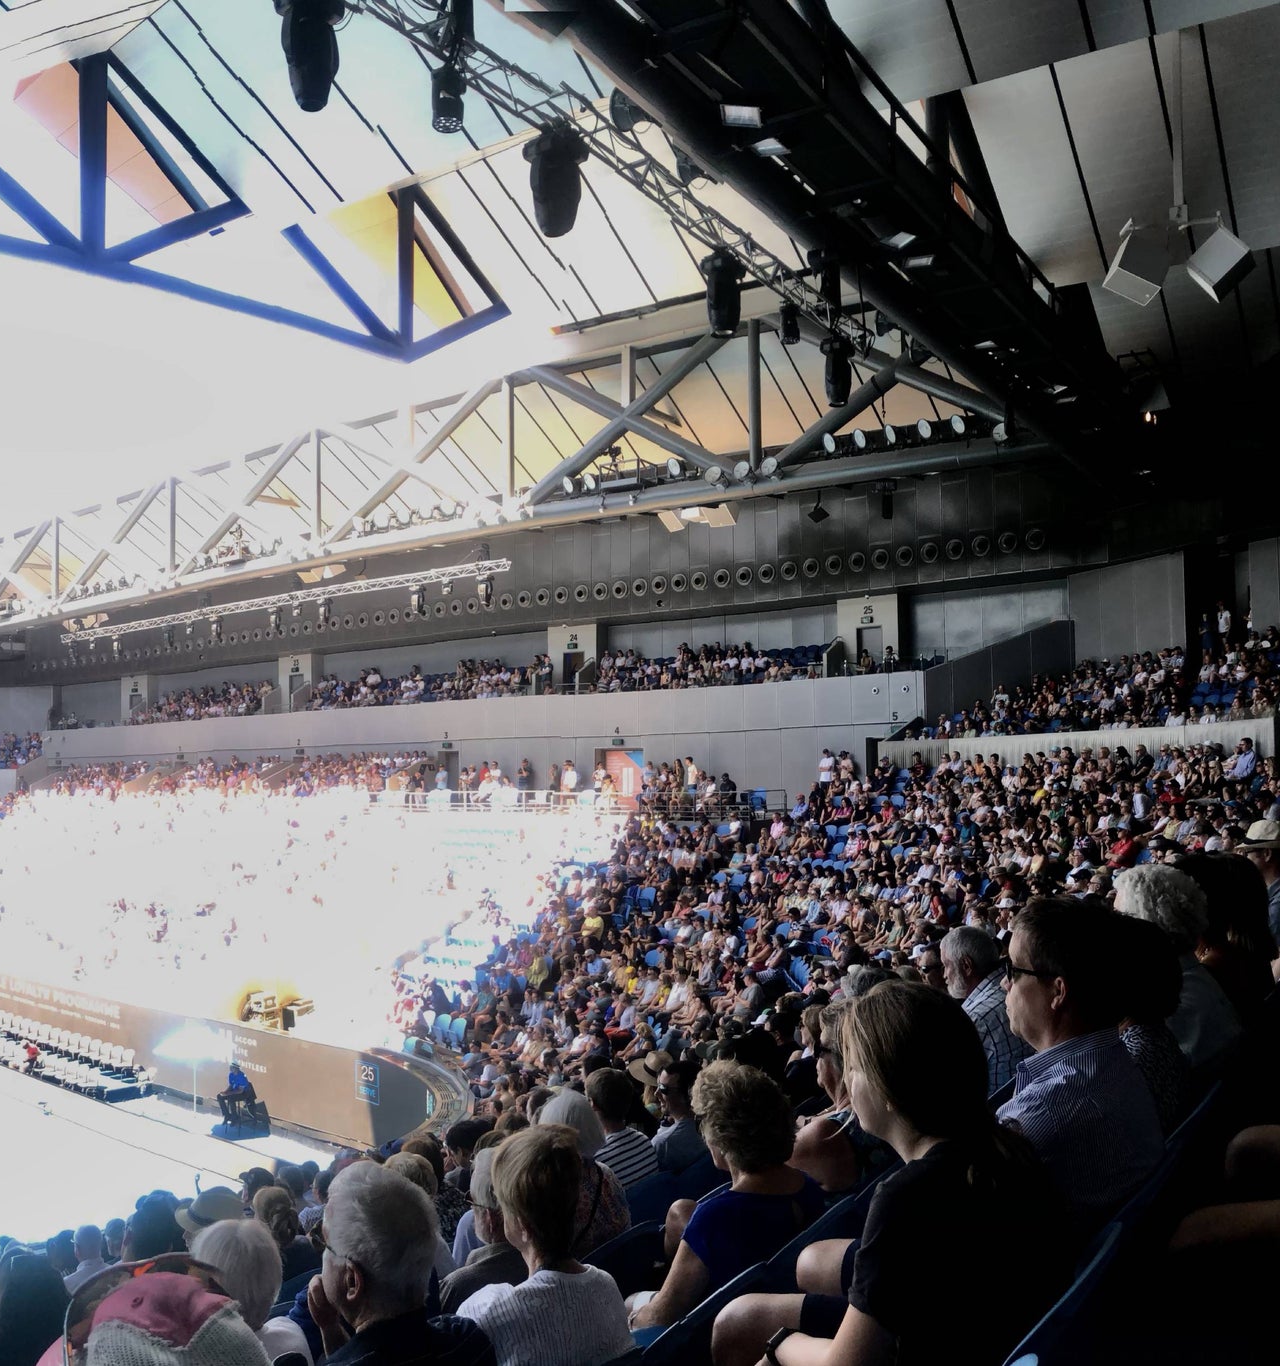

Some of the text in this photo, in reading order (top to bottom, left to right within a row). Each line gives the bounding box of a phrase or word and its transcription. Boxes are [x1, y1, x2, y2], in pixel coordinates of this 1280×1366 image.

[864, 606, 873, 614] 25
[892, 712, 898, 720] 5
[234, 1036, 257, 1047] ACCOR
[234, 1047, 248, 1057] LIVE
[361, 1065, 374, 1082] 25
[360, 1086, 376, 1098] SERVE
